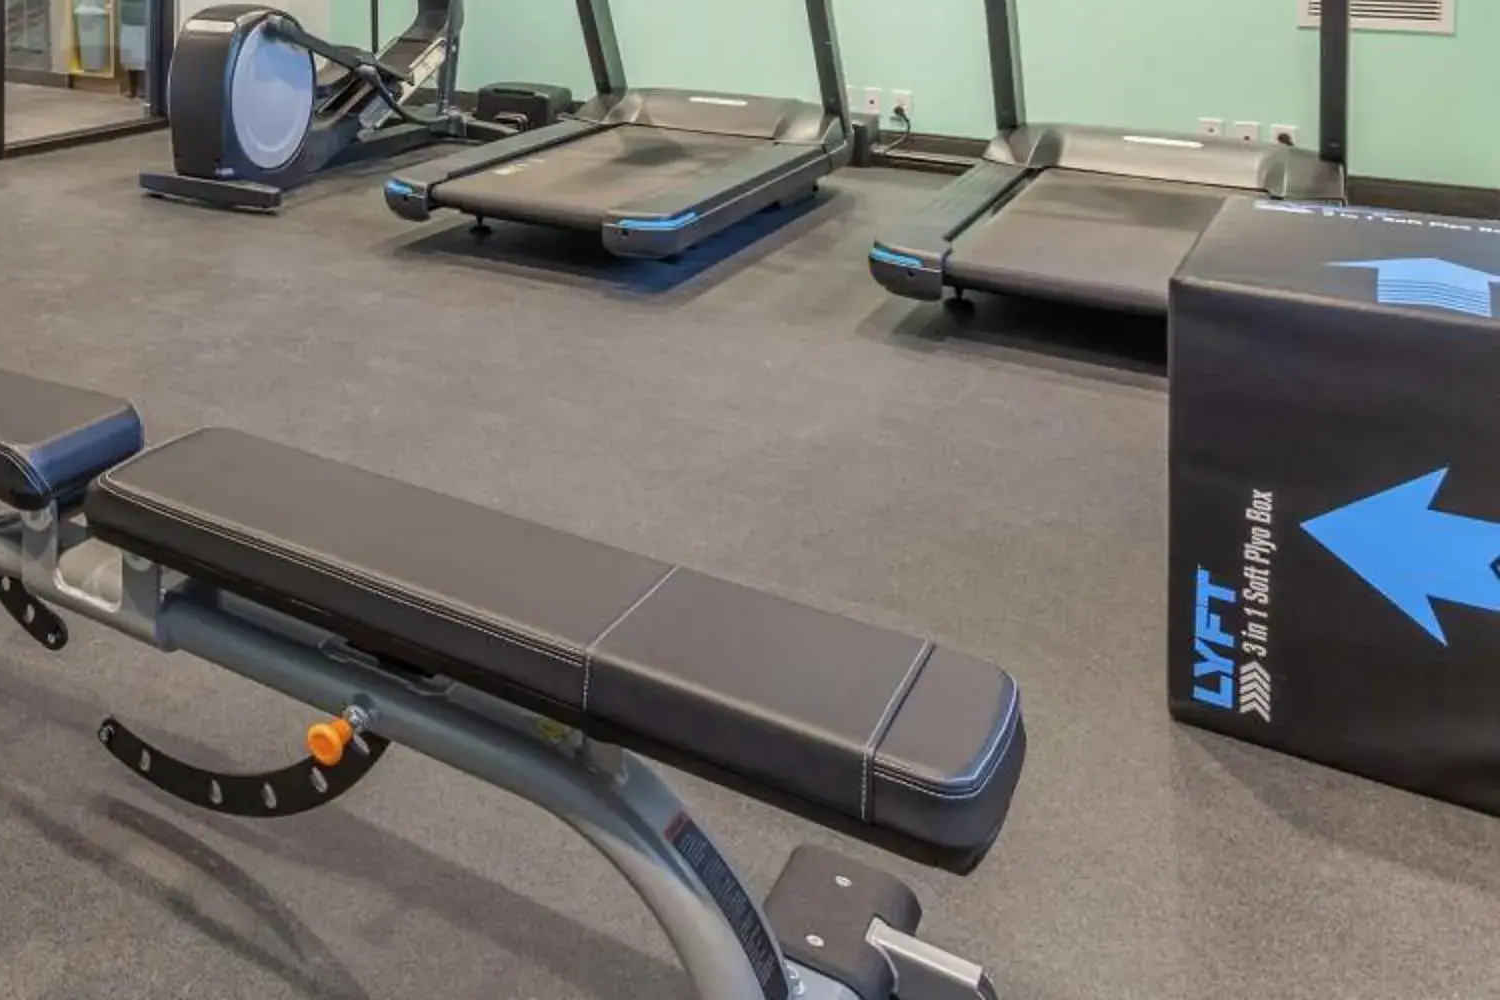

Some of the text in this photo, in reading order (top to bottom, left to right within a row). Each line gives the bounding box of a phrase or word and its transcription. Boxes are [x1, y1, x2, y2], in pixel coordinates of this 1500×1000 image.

[1193, 564, 1237, 709] LYFT
[1241, 488, 1277, 657] 3 in 1 Soft Plyo Box
